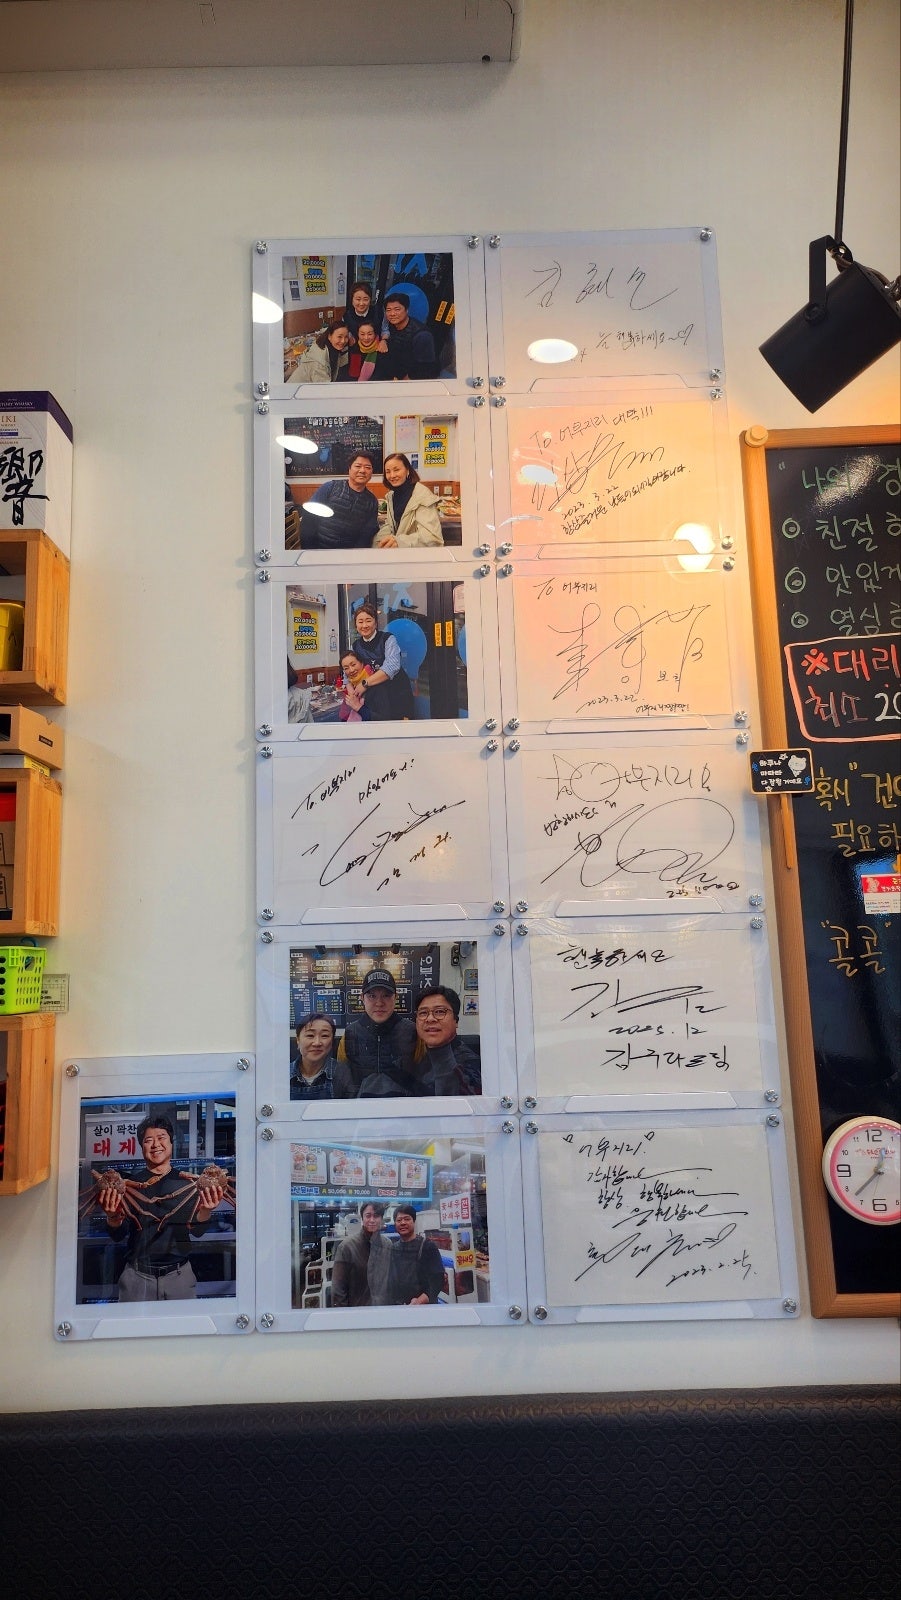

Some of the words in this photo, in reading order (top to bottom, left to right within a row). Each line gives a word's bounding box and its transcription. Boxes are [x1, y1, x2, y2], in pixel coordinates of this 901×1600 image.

[801, 462, 855, 498] 나의
[93, 1124, 113, 1137] 살이
[865, 1129, 882, 1142] 12
[836, 1164, 852, 1178] 9
[872, 1198, 888, 1212] 6
